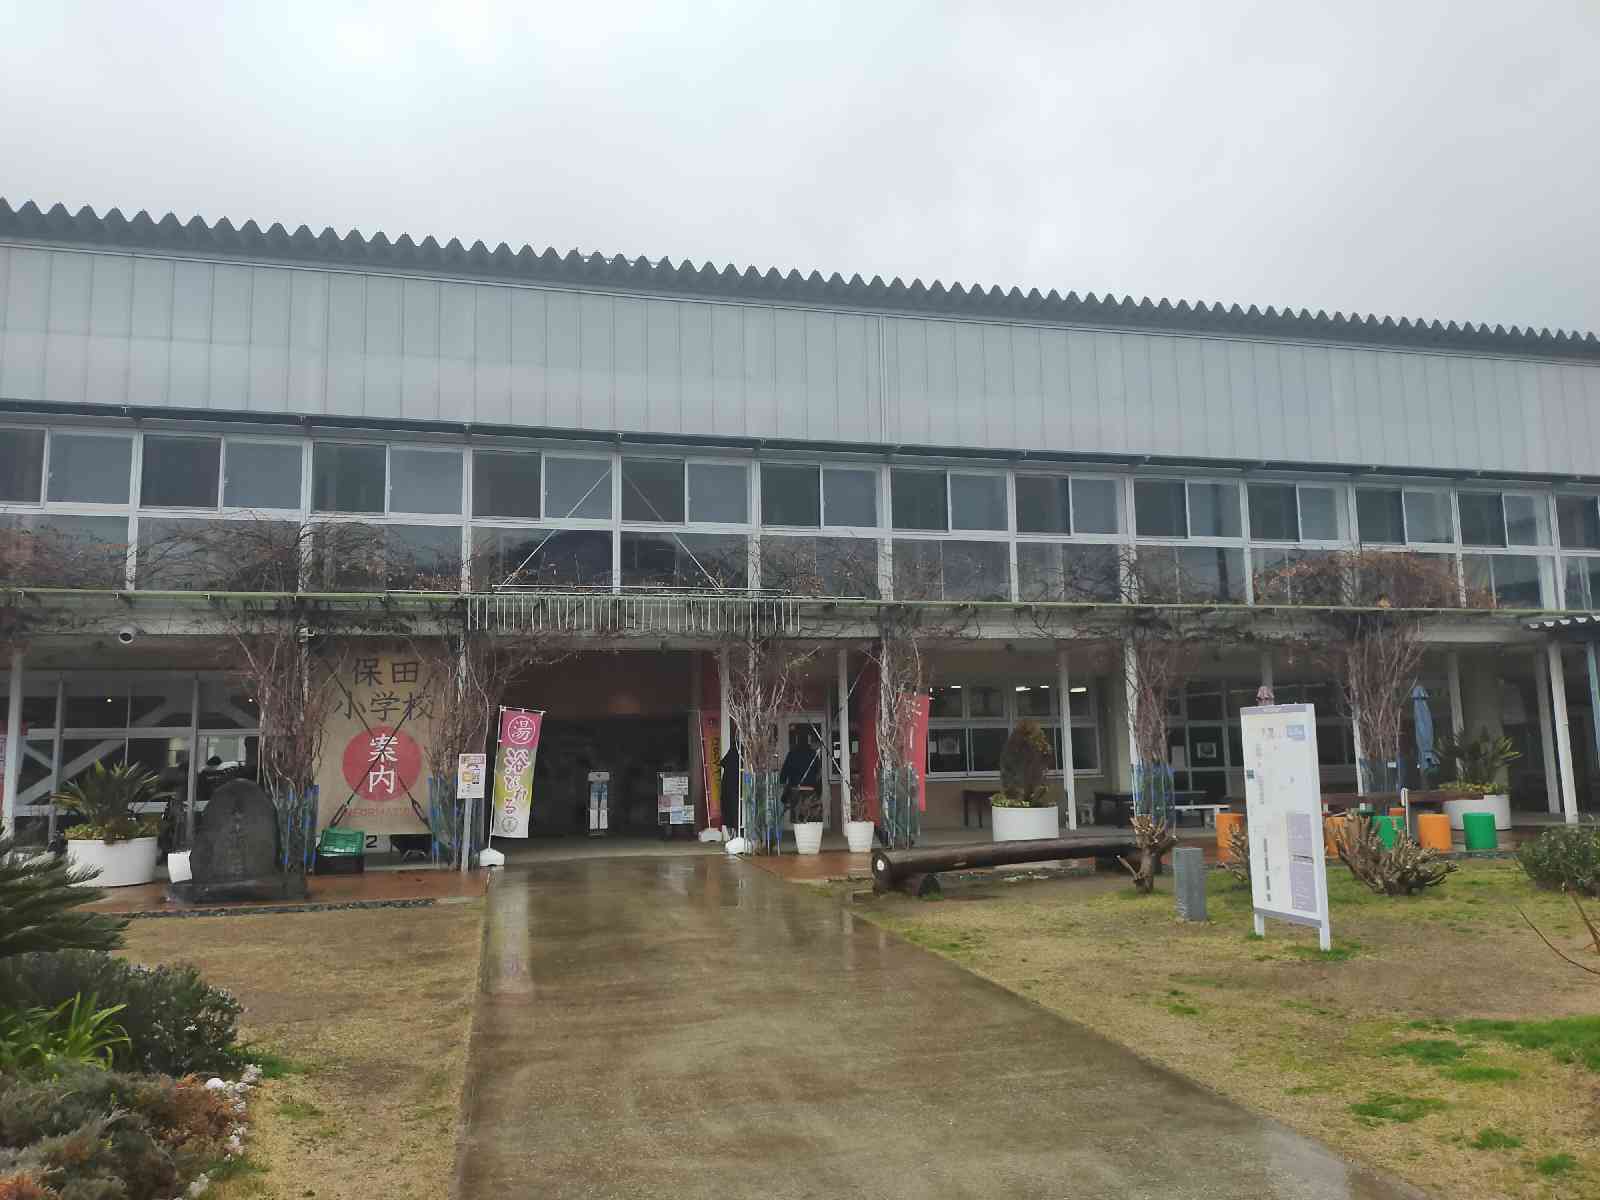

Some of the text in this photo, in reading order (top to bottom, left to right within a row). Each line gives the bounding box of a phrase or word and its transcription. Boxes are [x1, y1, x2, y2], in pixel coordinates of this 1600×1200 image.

[352, 657, 418, 686] 保田
[334, 691, 434, 720] 小学校
[511, 719, 533, 741] 湯
[367, 734, 399, 794] 案内
